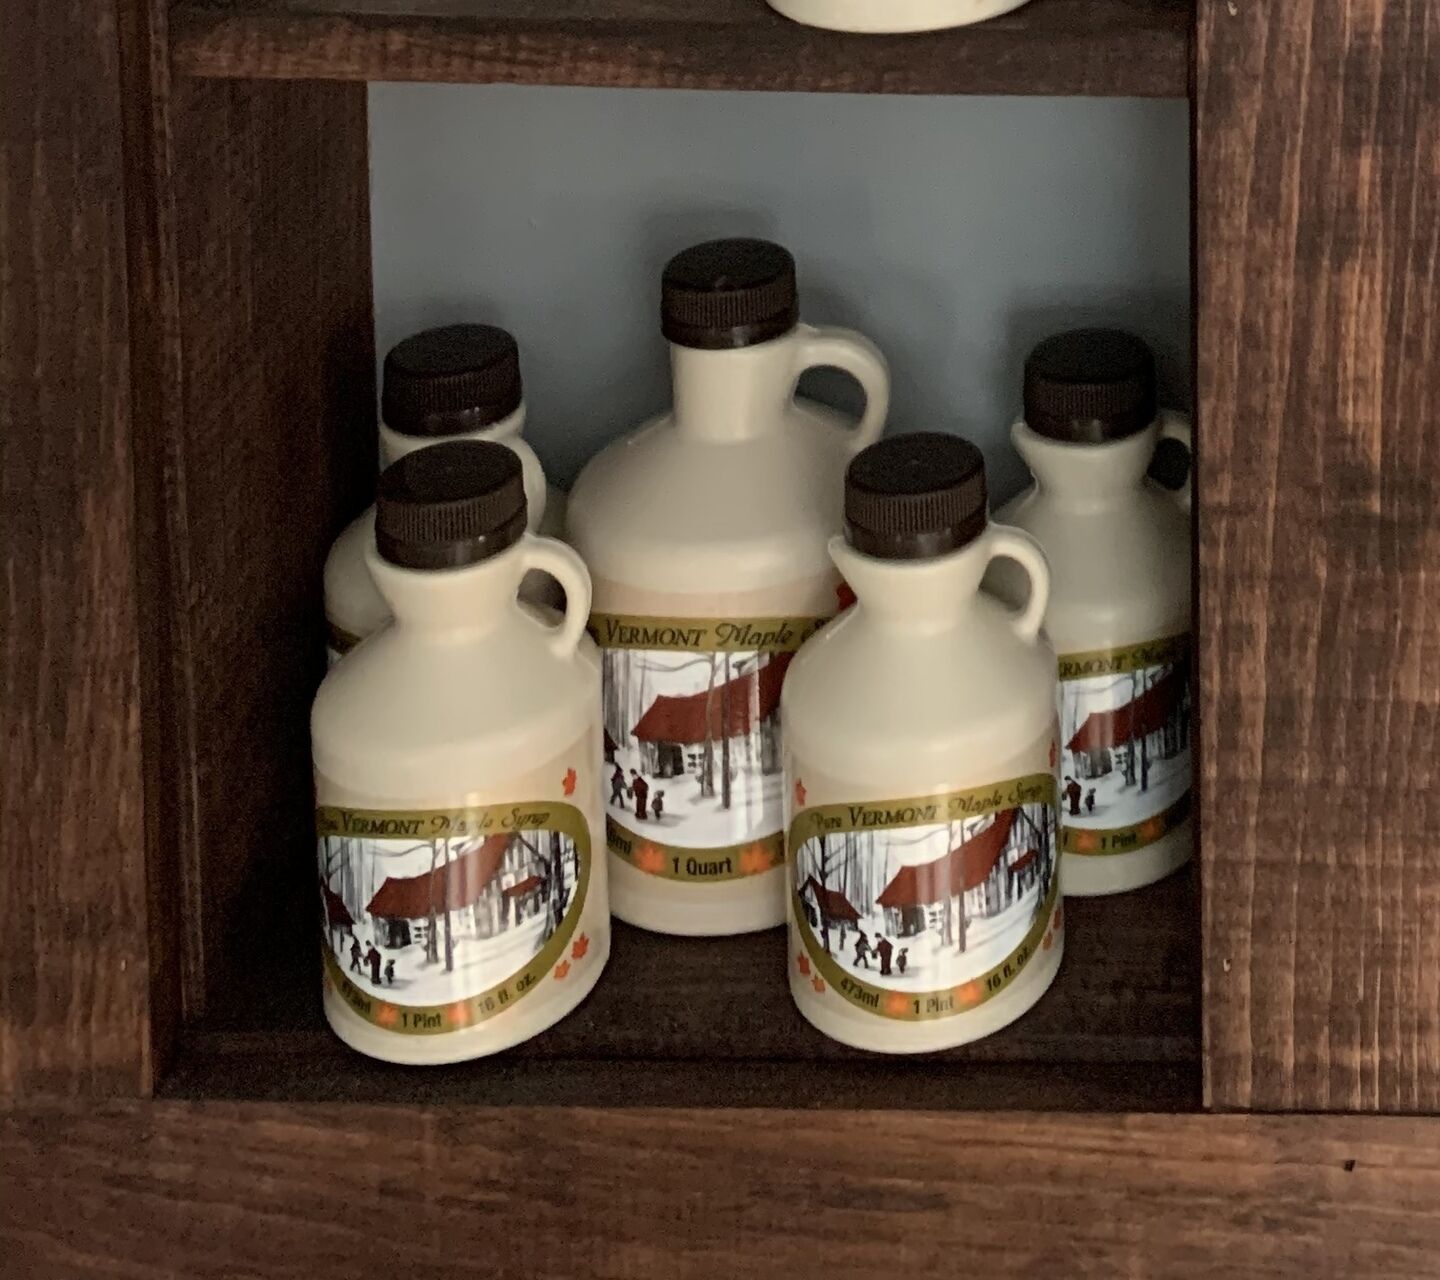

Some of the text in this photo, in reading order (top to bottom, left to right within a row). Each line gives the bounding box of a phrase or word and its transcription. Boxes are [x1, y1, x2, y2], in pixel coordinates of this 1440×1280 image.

[605, 618, 707, 648] VERMONT
[715, 619, 794, 651] Maple
[338, 812, 425, 836] VERMONT
[848, 804, 938, 828] VERMONT
[672, 856, 733, 877] 1 Quart
[839, 977, 880, 1010] 473ml
[913, 998, 920, 1014] 1
[987, 972, 1002, 992] 16
[402, 1013, 408, 1027] 1
[412, 1011, 443, 1029] Pint
